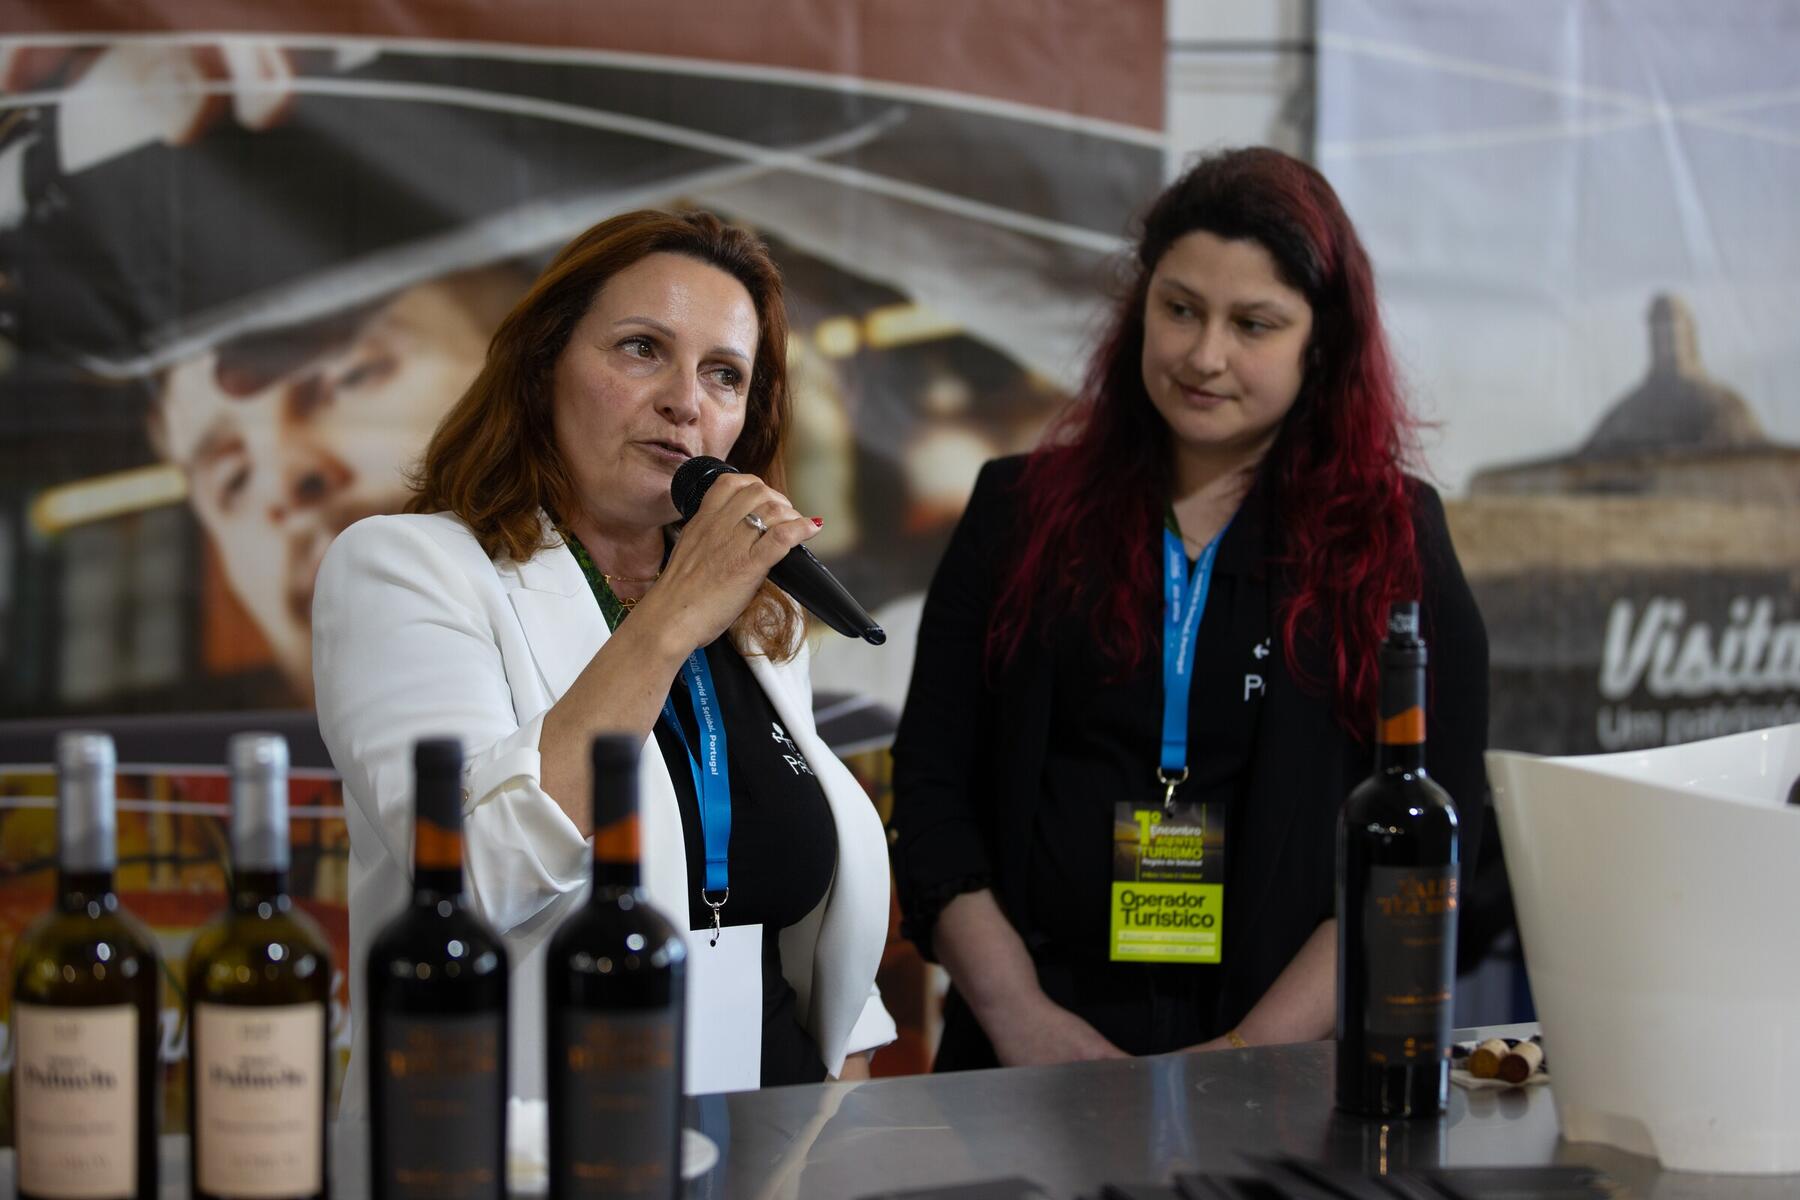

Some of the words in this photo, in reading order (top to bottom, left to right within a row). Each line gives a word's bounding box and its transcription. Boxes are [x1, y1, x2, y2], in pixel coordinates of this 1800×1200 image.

[1244, 674, 1266, 701] P
[694, 675, 706, 697] world
[700, 696, 708, 706] in
[709, 734, 719, 776] Portugal
[1150, 826, 1202, 837] Encontro
[1141, 846, 1204, 860] TURISMO
[1120, 889, 1207, 910] Operador
[1120, 907, 1215, 928] Turístico
